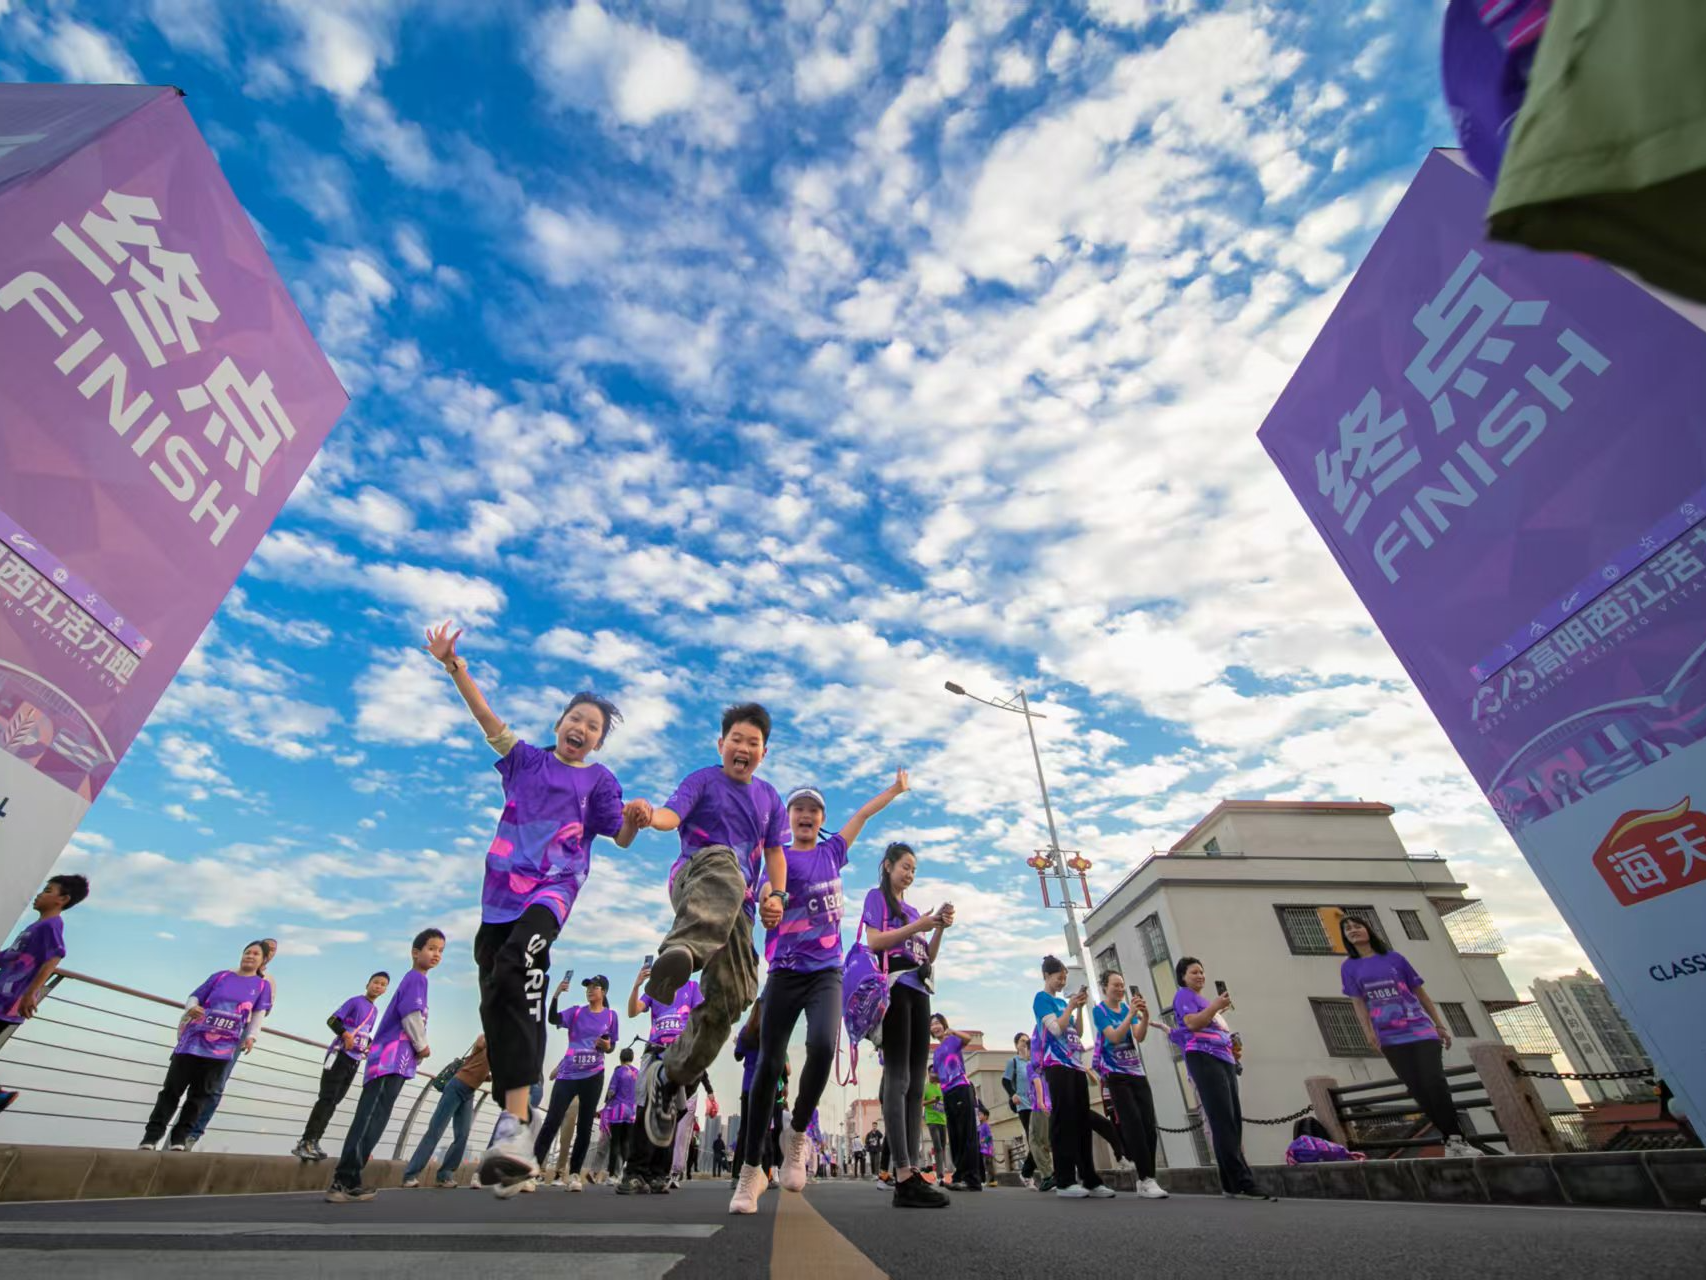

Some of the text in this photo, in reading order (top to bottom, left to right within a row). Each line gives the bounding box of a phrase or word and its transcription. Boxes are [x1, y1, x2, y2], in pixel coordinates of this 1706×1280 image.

[52, 189, 297, 496] 终点
[1315, 248, 1550, 536] 终点
[0, 270, 241, 547] FINISH
[1373, 327, 1612, 585] FINISH
[0, 543, 141, 685] 西江活力跑
[32, 620, 94, 671] VITALITY
[1657, 574, 1706, 613] VITA
[808, 898, 819, 911] C
[1606, 822, 1706, 894] 海天
[1649, 953, 1706, 981] CLASS
